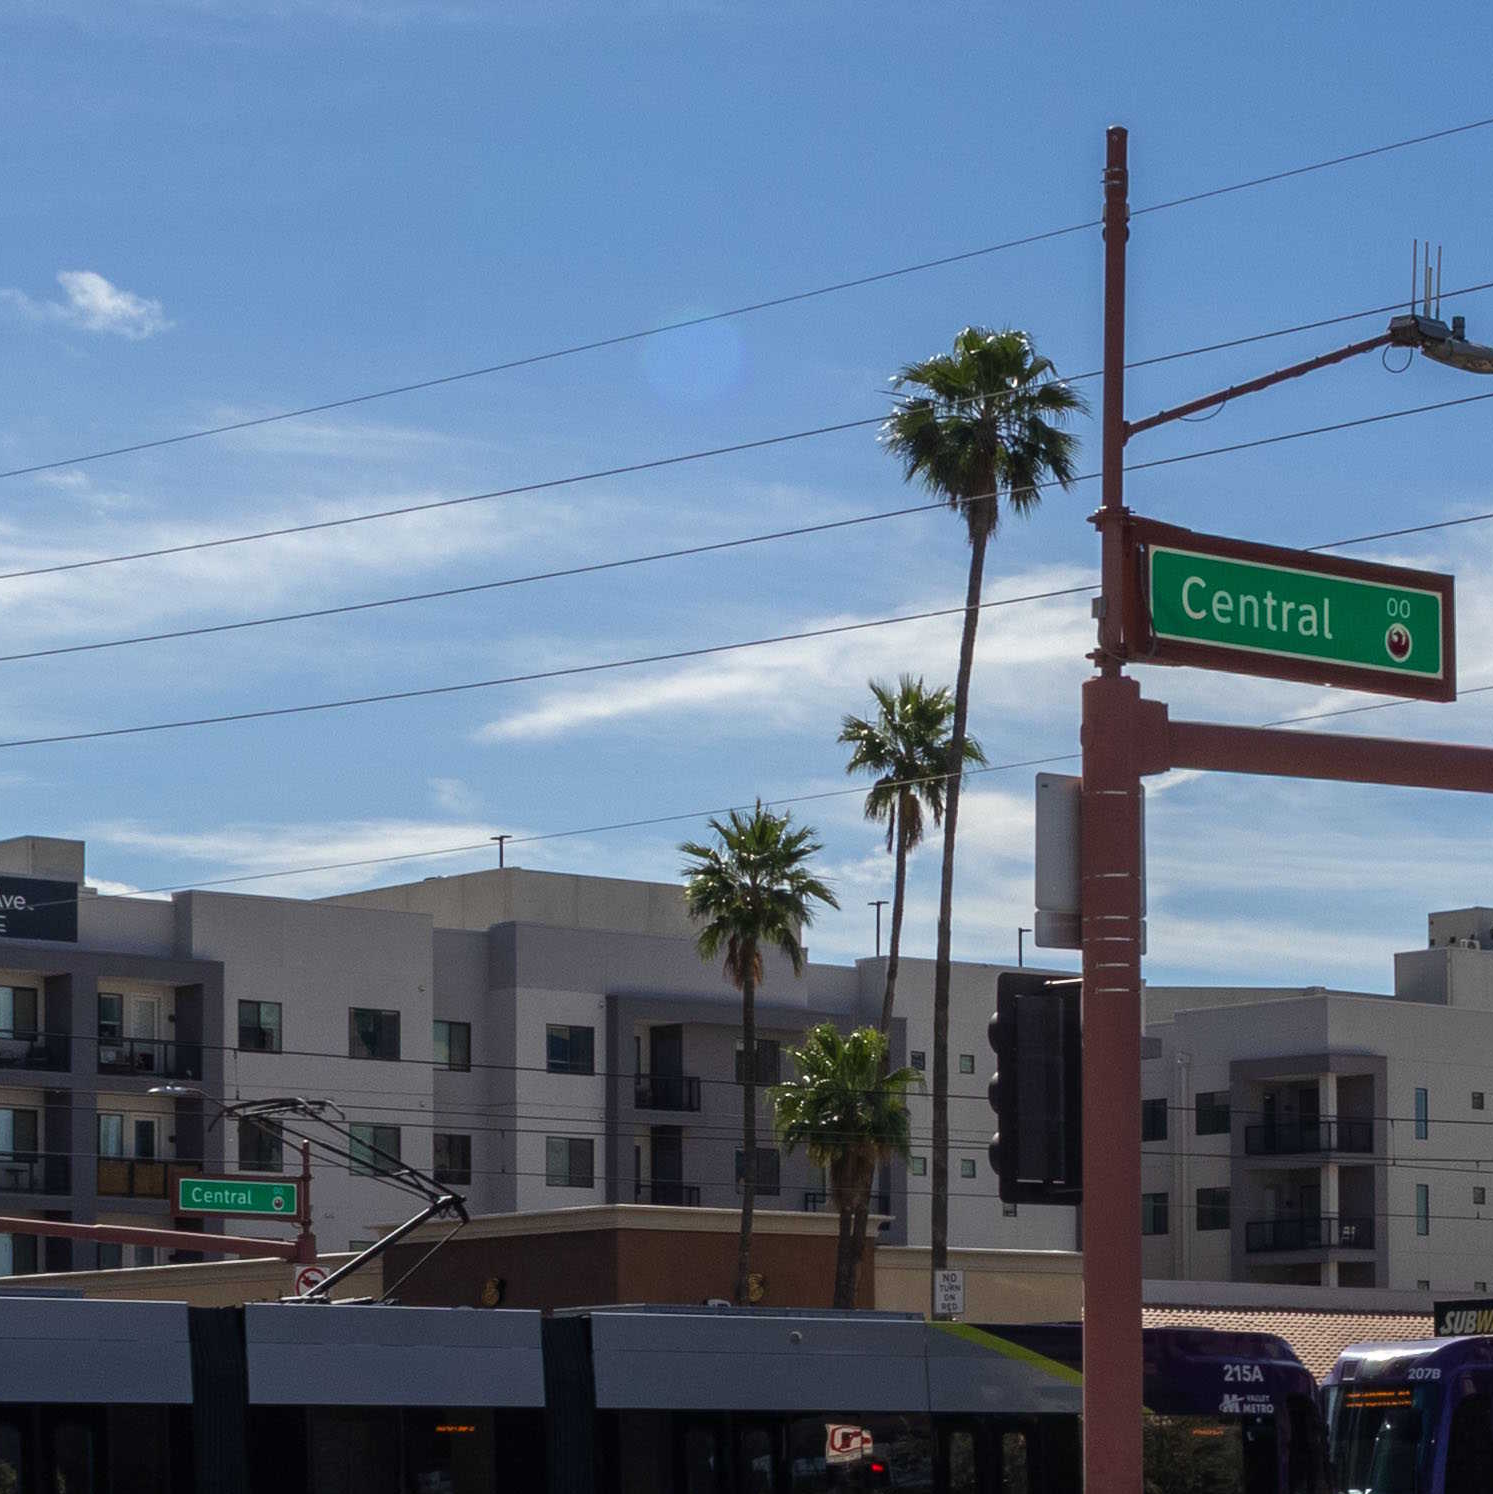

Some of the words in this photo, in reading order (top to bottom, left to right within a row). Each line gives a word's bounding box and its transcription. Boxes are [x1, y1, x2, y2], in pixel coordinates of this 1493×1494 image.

[1181, 575, 1333, 640] Central
[1386, 597, 1411, 619] 00
[191, 1186, 252, 1205] Central
[942, 1273, 957, 1283] NO
[1223, 1364, 1264, 1382] 215A
[1408, 1367, 1442, 1380] 207B
[1242, 1404, 1274, 1414] METRO
